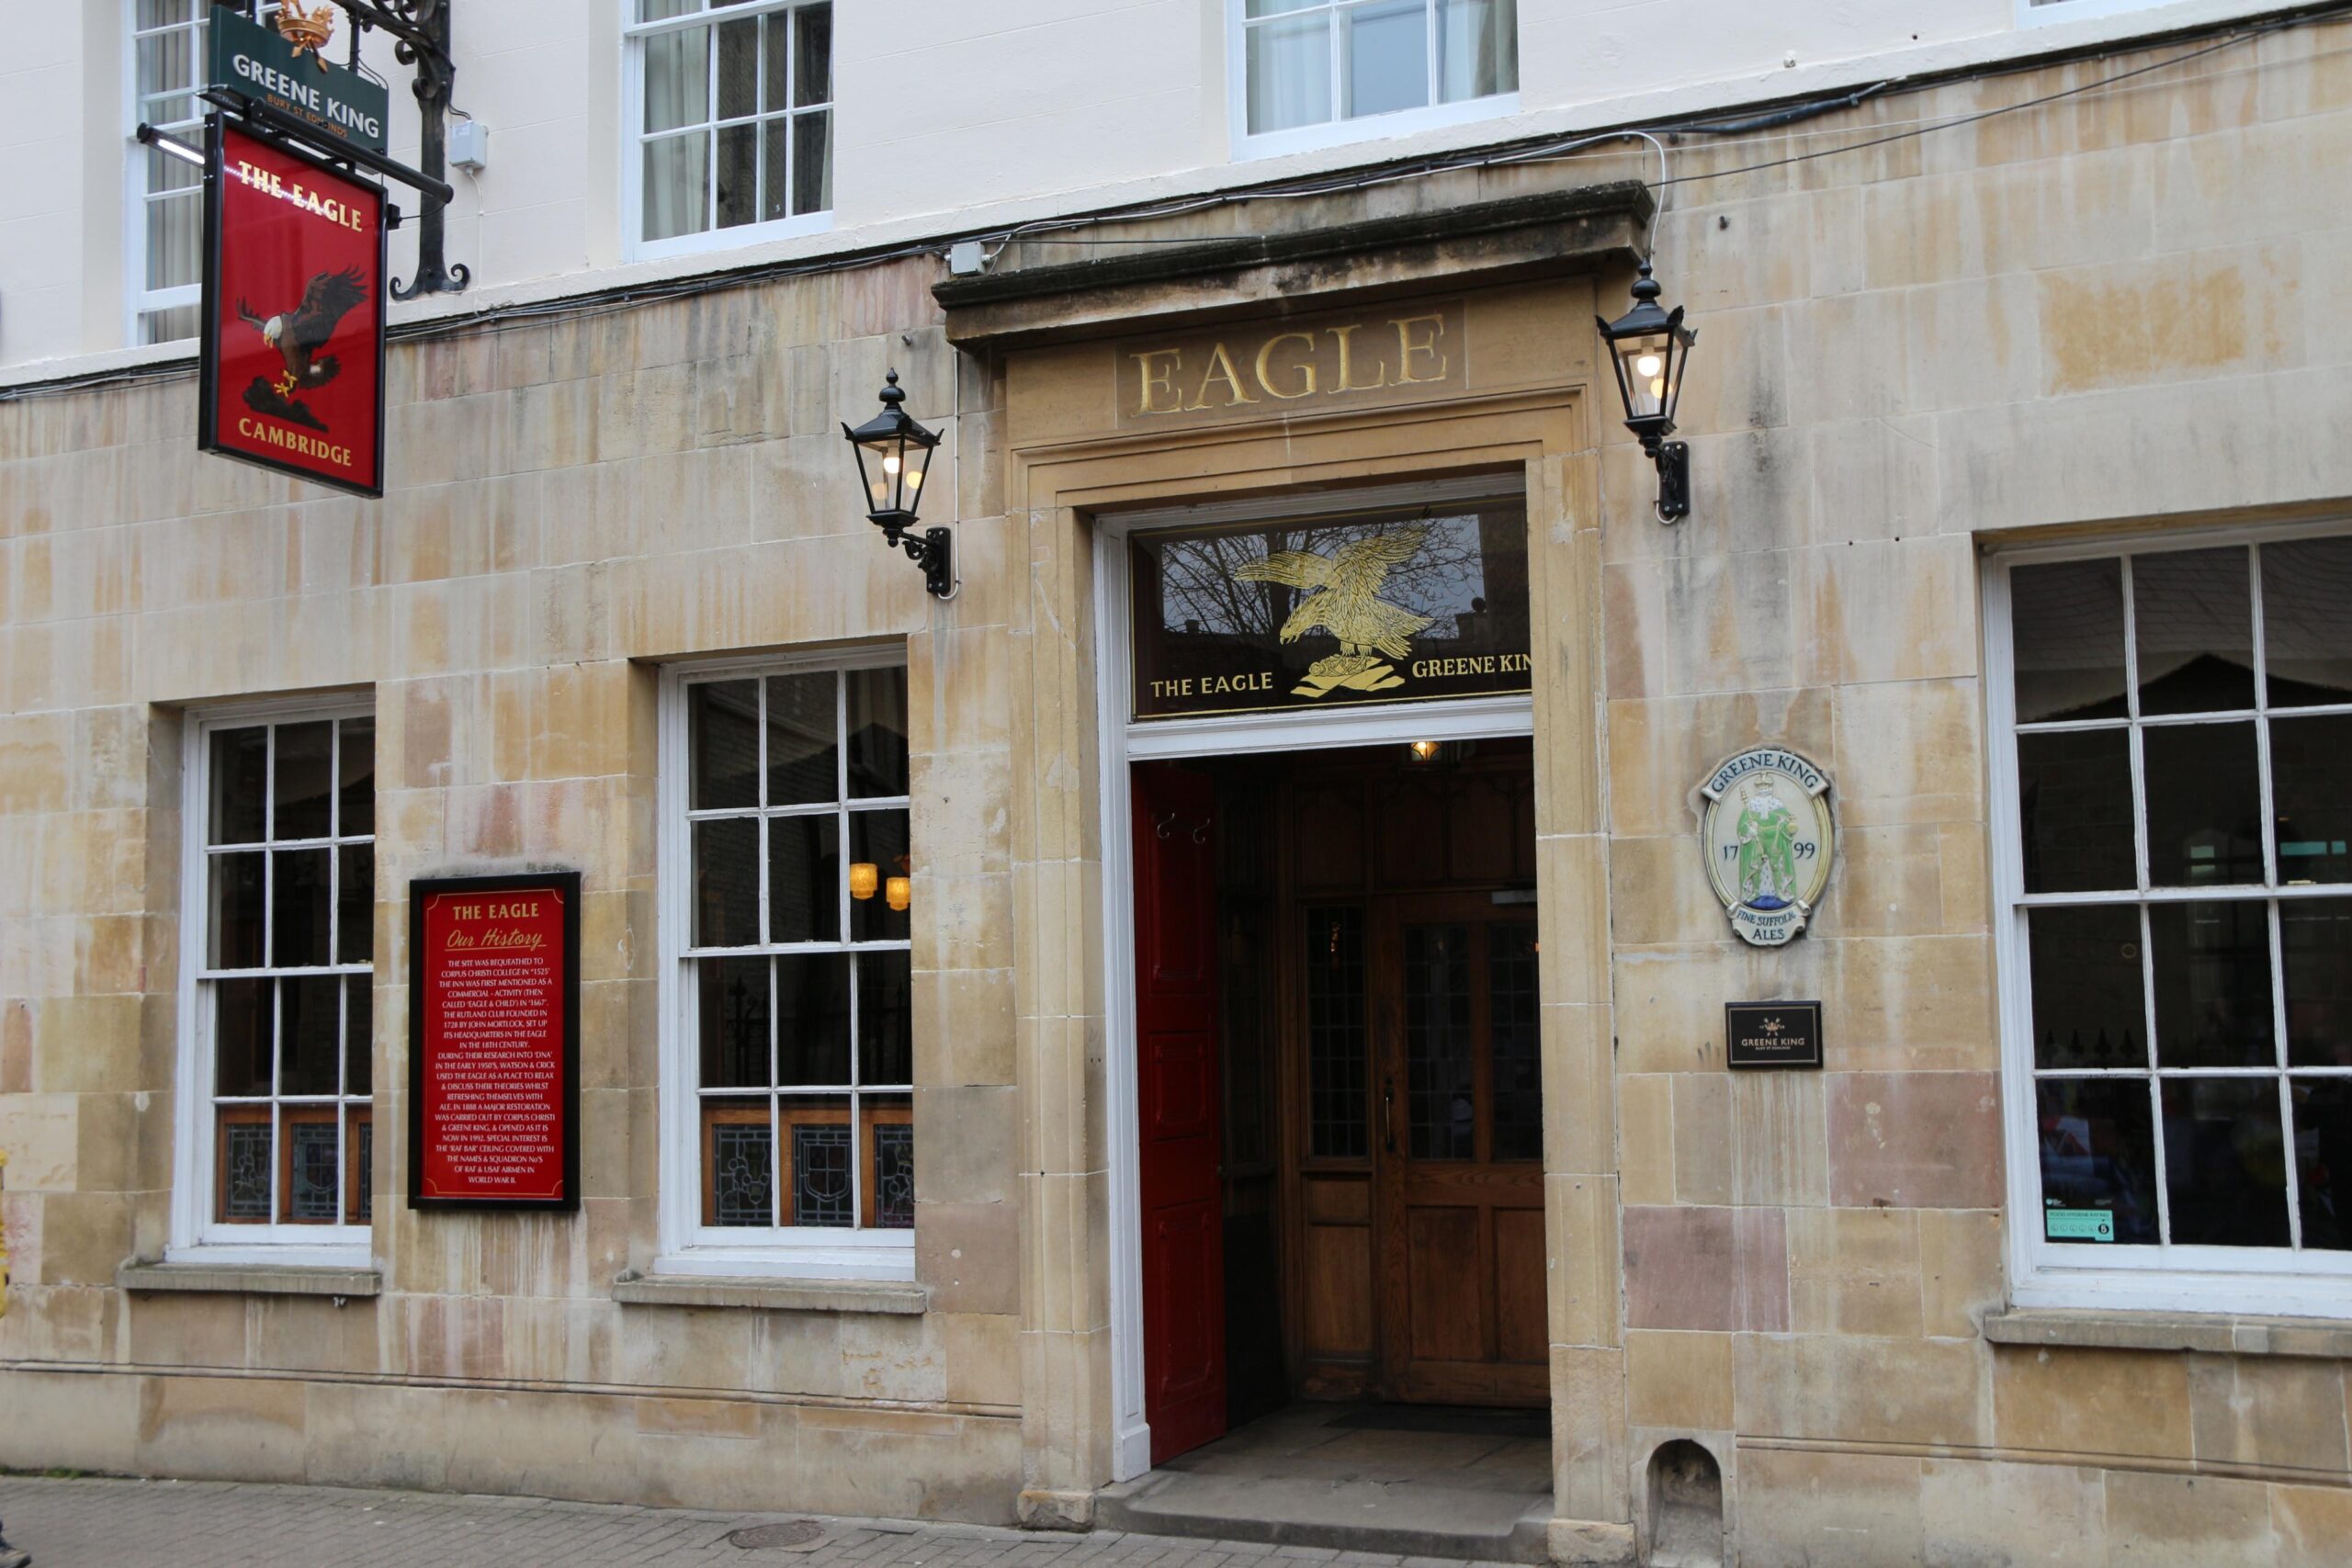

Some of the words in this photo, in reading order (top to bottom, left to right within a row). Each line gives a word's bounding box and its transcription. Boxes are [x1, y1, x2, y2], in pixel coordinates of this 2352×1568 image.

[232, 54, 320, 111] GREENE
[327, 97, 379, 139] KING
[266, 94, 290, 110] BURY
[293, 107, 302, 117] ST
[239, 161, 283, 199] THE
[292, 184, 362, 232] EAGLE
[1129, 314, 1447, 418] EAGLE
[239, 418, 352, 468] CAMBRIDGE
[1412, 656, 1496, 678] GREENE
[1499, 654, 1532, 672] KIN
[1150, 679, 1193, 697] THE
[1201, 672, 1273, 694] EAGLE
[1712, 753, 1773, 793] GREENE
[1777, 756, 1818, 789] KING
[1723, 844, 1739, 861] 17
[1793, 842, 1815, 860] 99
[453, 906, 481, 919] THE
[489, 903, 539, 919] EAGLE
[1737, 909, 1756, 924] FINE
[1757, 911, 1796, 926] SUFFOLK
[447, 930, 474, 947] Our
[481, 928, 542, 952] History
[1752, 928, 1784, 940] ALES
[491, 958, 532, 966] BEQUEATHED
[1741, 1038, 1778, 1046] GREENE
